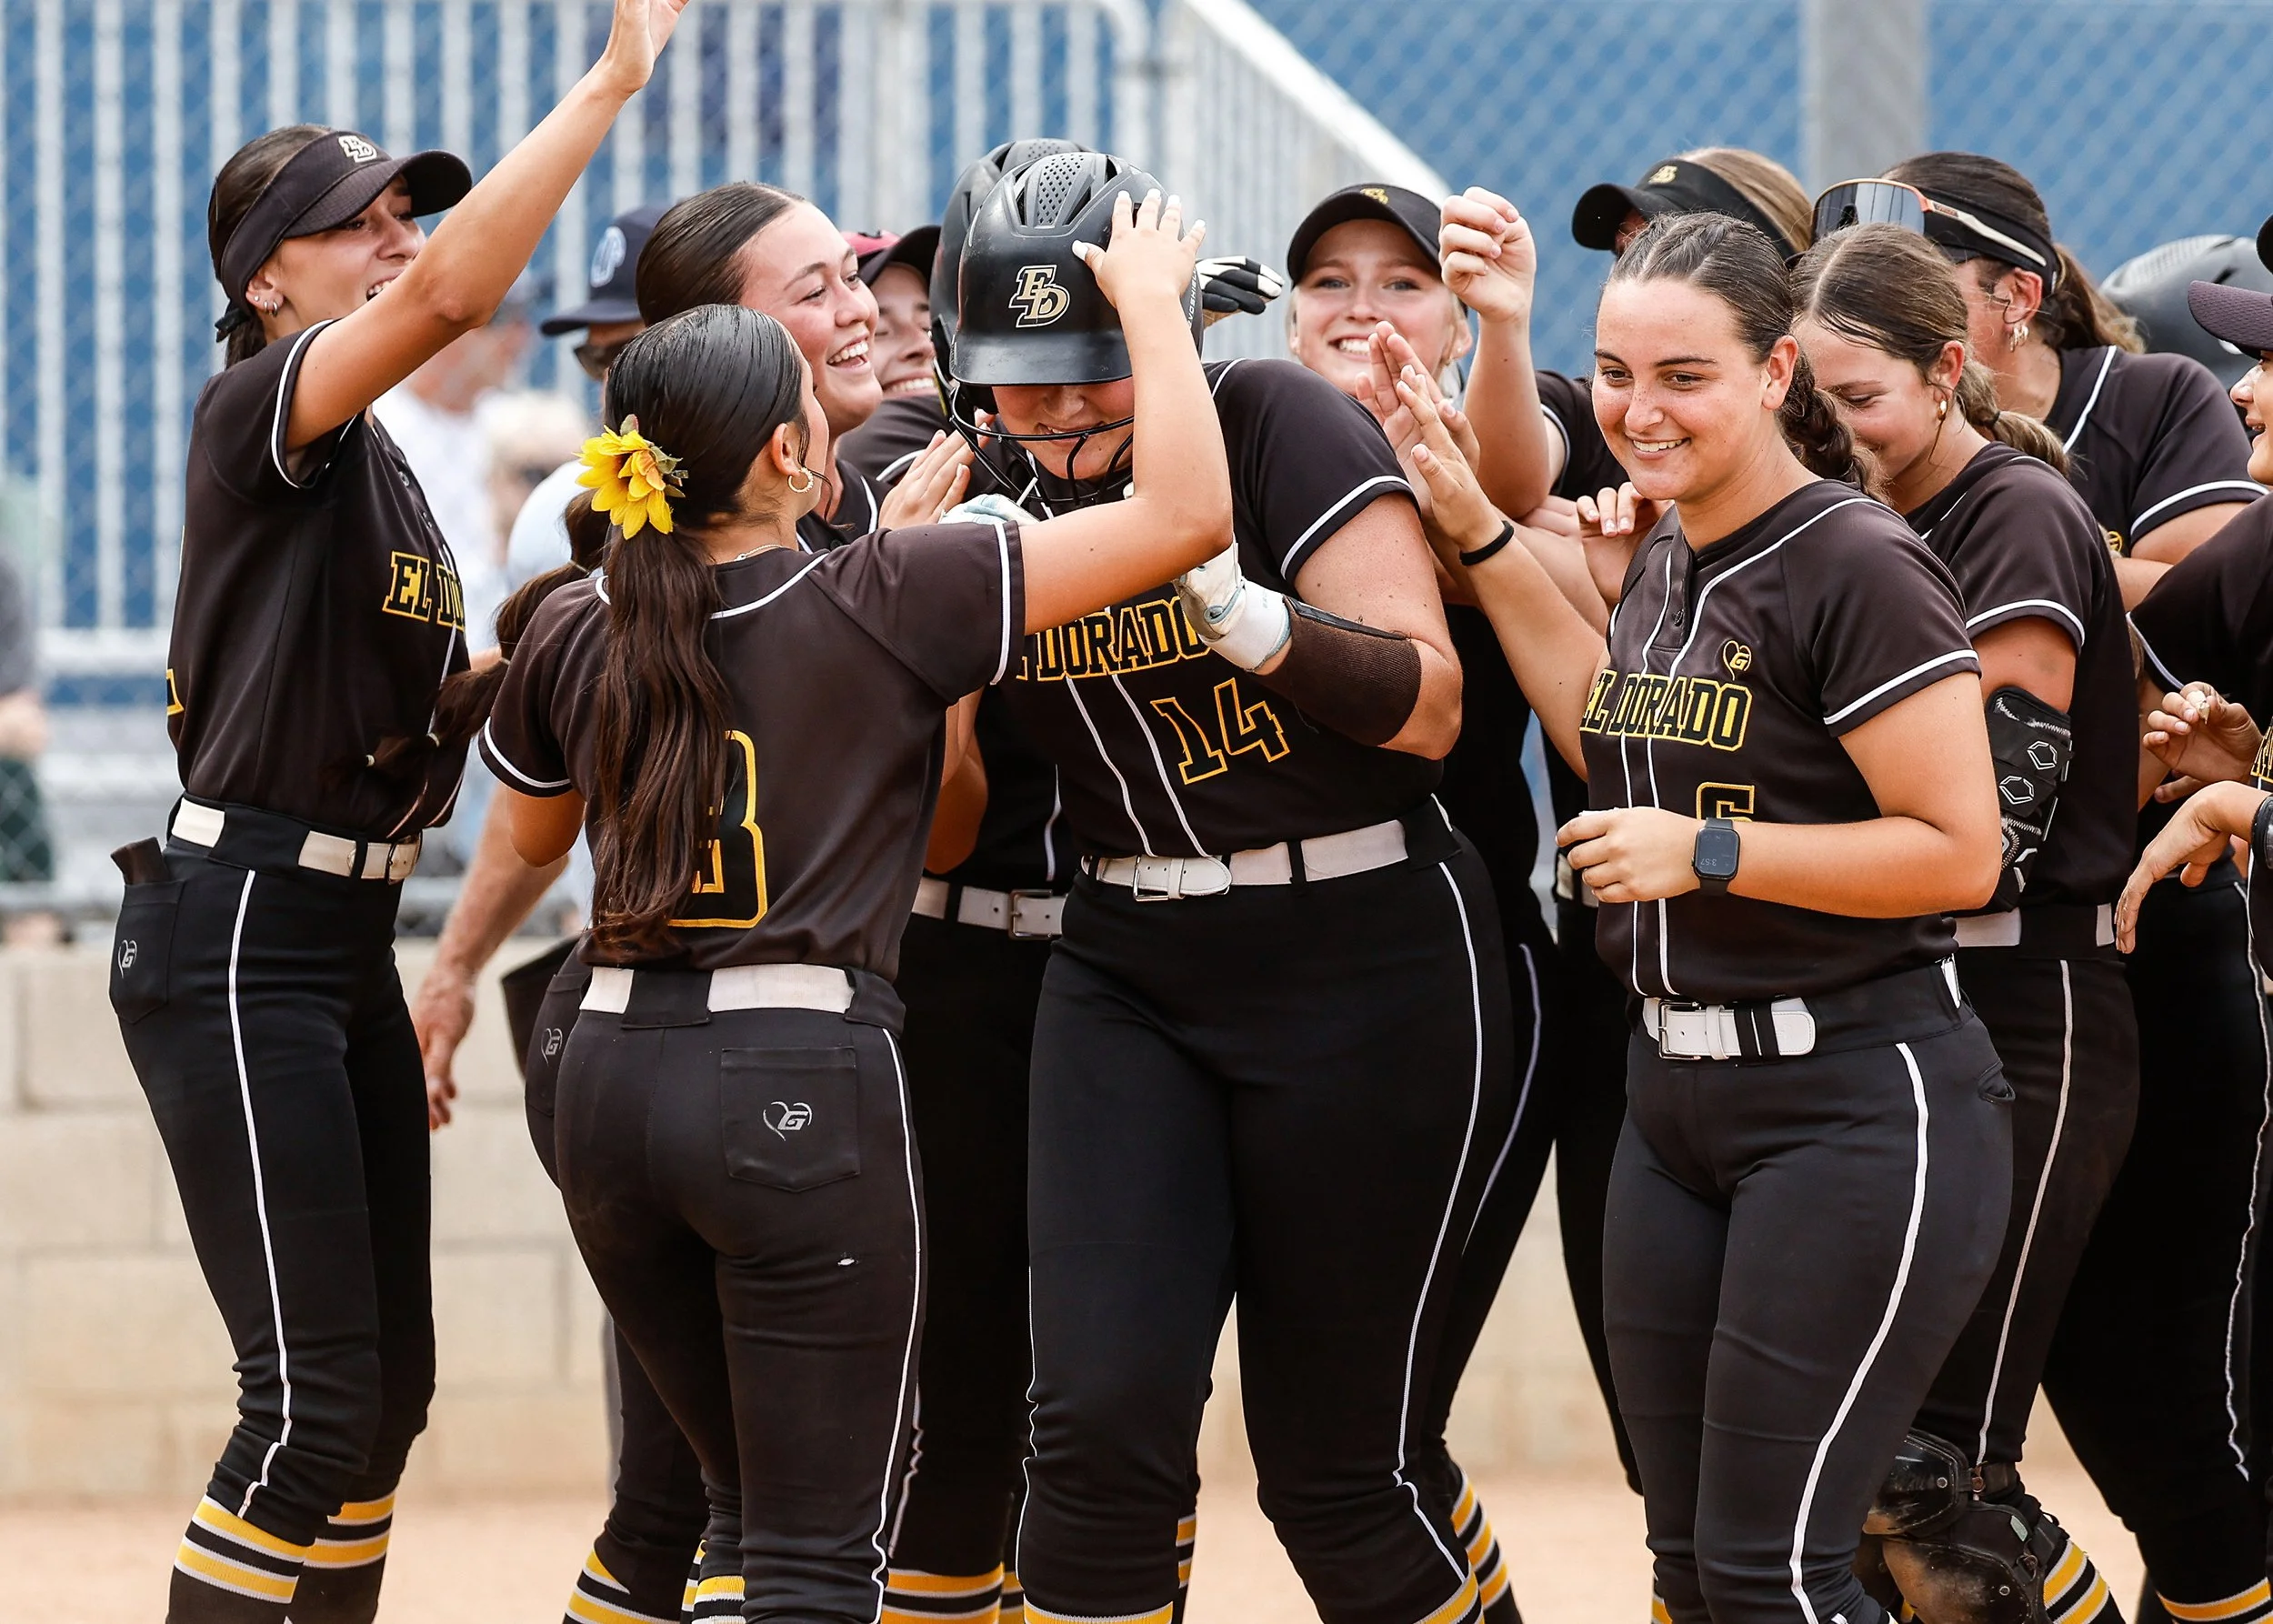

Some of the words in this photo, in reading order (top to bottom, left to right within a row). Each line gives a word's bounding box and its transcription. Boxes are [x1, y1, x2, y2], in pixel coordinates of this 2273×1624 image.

[1008, 265, 1071, 327] ED
[1187, 266, 1197, 326] VOSHIEL
[382, 551, 433, 622] EL
[1150, 677, 1290, 785] 14
[1606, 673, 1753, 751] DORADO
